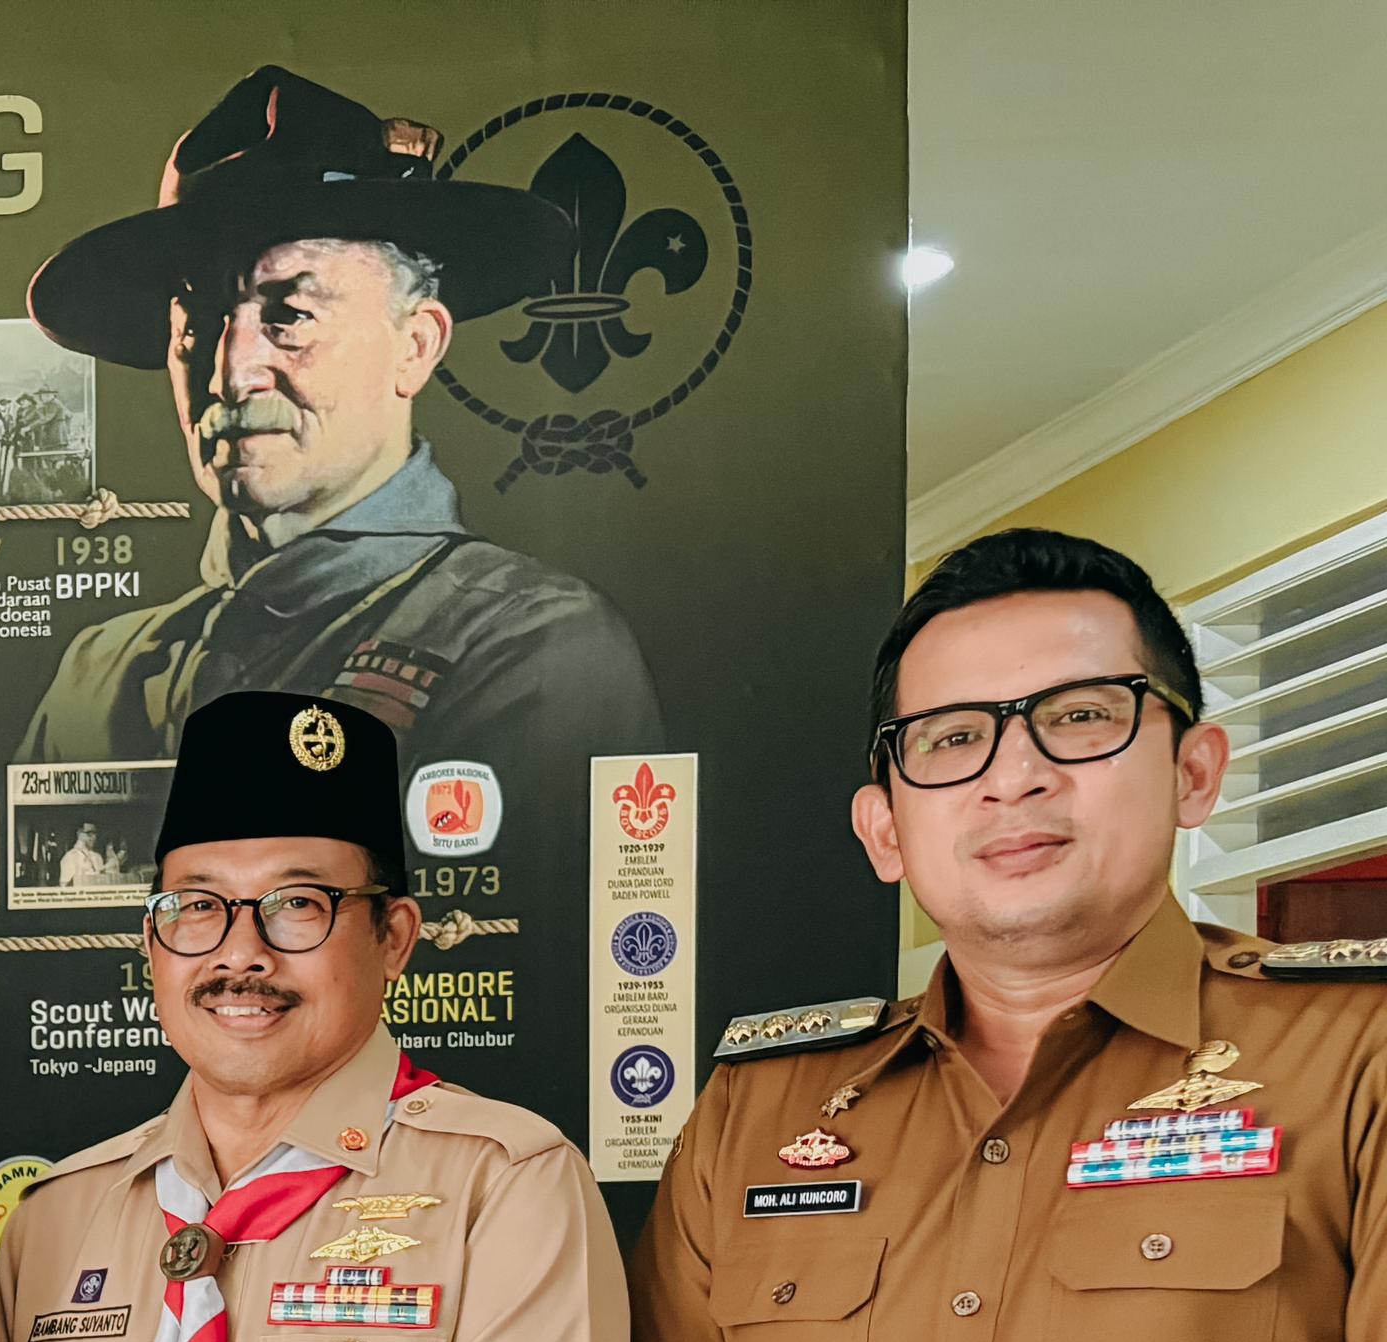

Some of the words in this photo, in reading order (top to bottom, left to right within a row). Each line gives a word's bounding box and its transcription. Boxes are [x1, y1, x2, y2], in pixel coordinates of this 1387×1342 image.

[56, 536, 134, 567] 1938
[6, 575, 52, 592] Pusat
[56, 573, 140, 600] BPPKI
[21, 771, 52, 796] 23rd
[53, 770, 92, 795] WORLD
[453, 835, 479, 848] BARU
[618, 843, 665, 853] 1920-1939
[413, 866, 501, 897] 1973
[646, 991, 669, 1001] BARU
[30, 999, 114, 1026] Scout
[447, 1029, 516, 1047] Cibubur
[30, 1059, 79, 1078] Tokyo
[754, 1193, 779, 1208] MOH.
[780, 1191, 796, 1206] ALI
[798, 1188, 847, 1205] KUNCORO
[79, 1313, 125, 1334] SUYANTO
